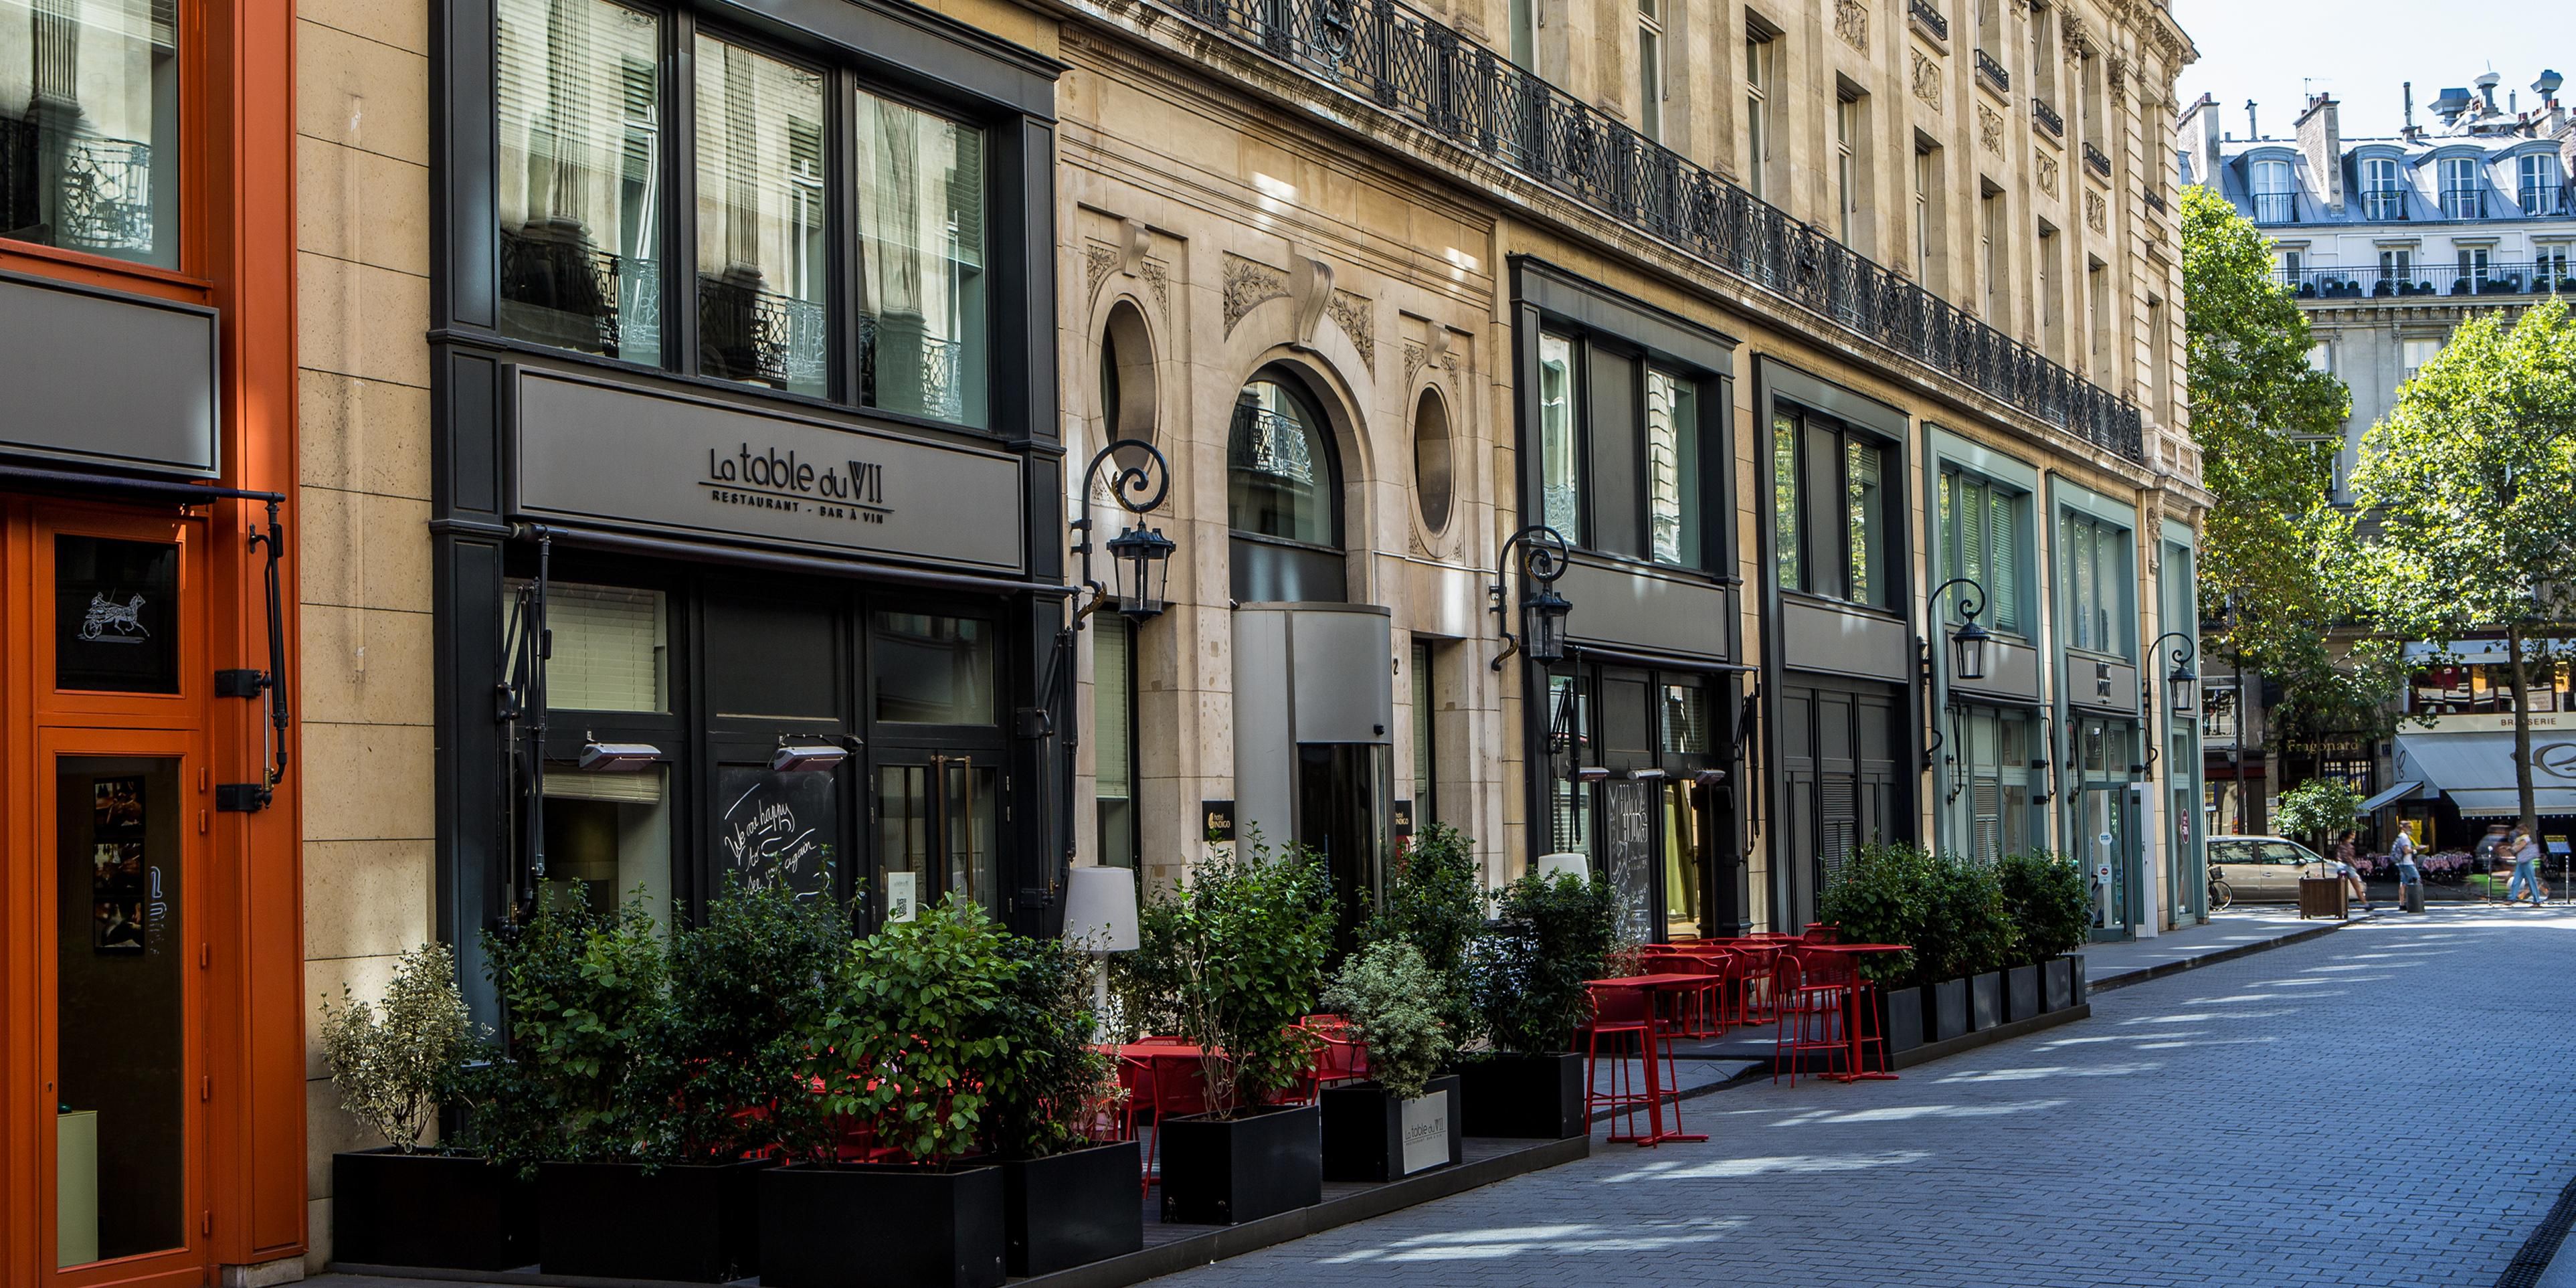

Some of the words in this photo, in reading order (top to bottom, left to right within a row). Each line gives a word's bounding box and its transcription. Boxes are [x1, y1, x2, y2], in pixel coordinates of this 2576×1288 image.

[711, 448, 735, 481] La
[740, 442, 815, 491] table
[820, 467, 847, 498] du
[848, 460, 883, 504] VII
[712, 490, 800, 512] RESTAURANT
[820, 506, 843, 519] BAR
[850, 509, 857, 520] À
[864, 513, 884, 524] VIN
[2500, 718, 2557, 726] BRSERIE
[725, 822, 745, 858] We
[759, 799, 795, 832] happy
[1212, 820, 1230, 828] INDIGO
[784, 841, 817, 873] again
[1411, 1123, 1428, 1138] table
